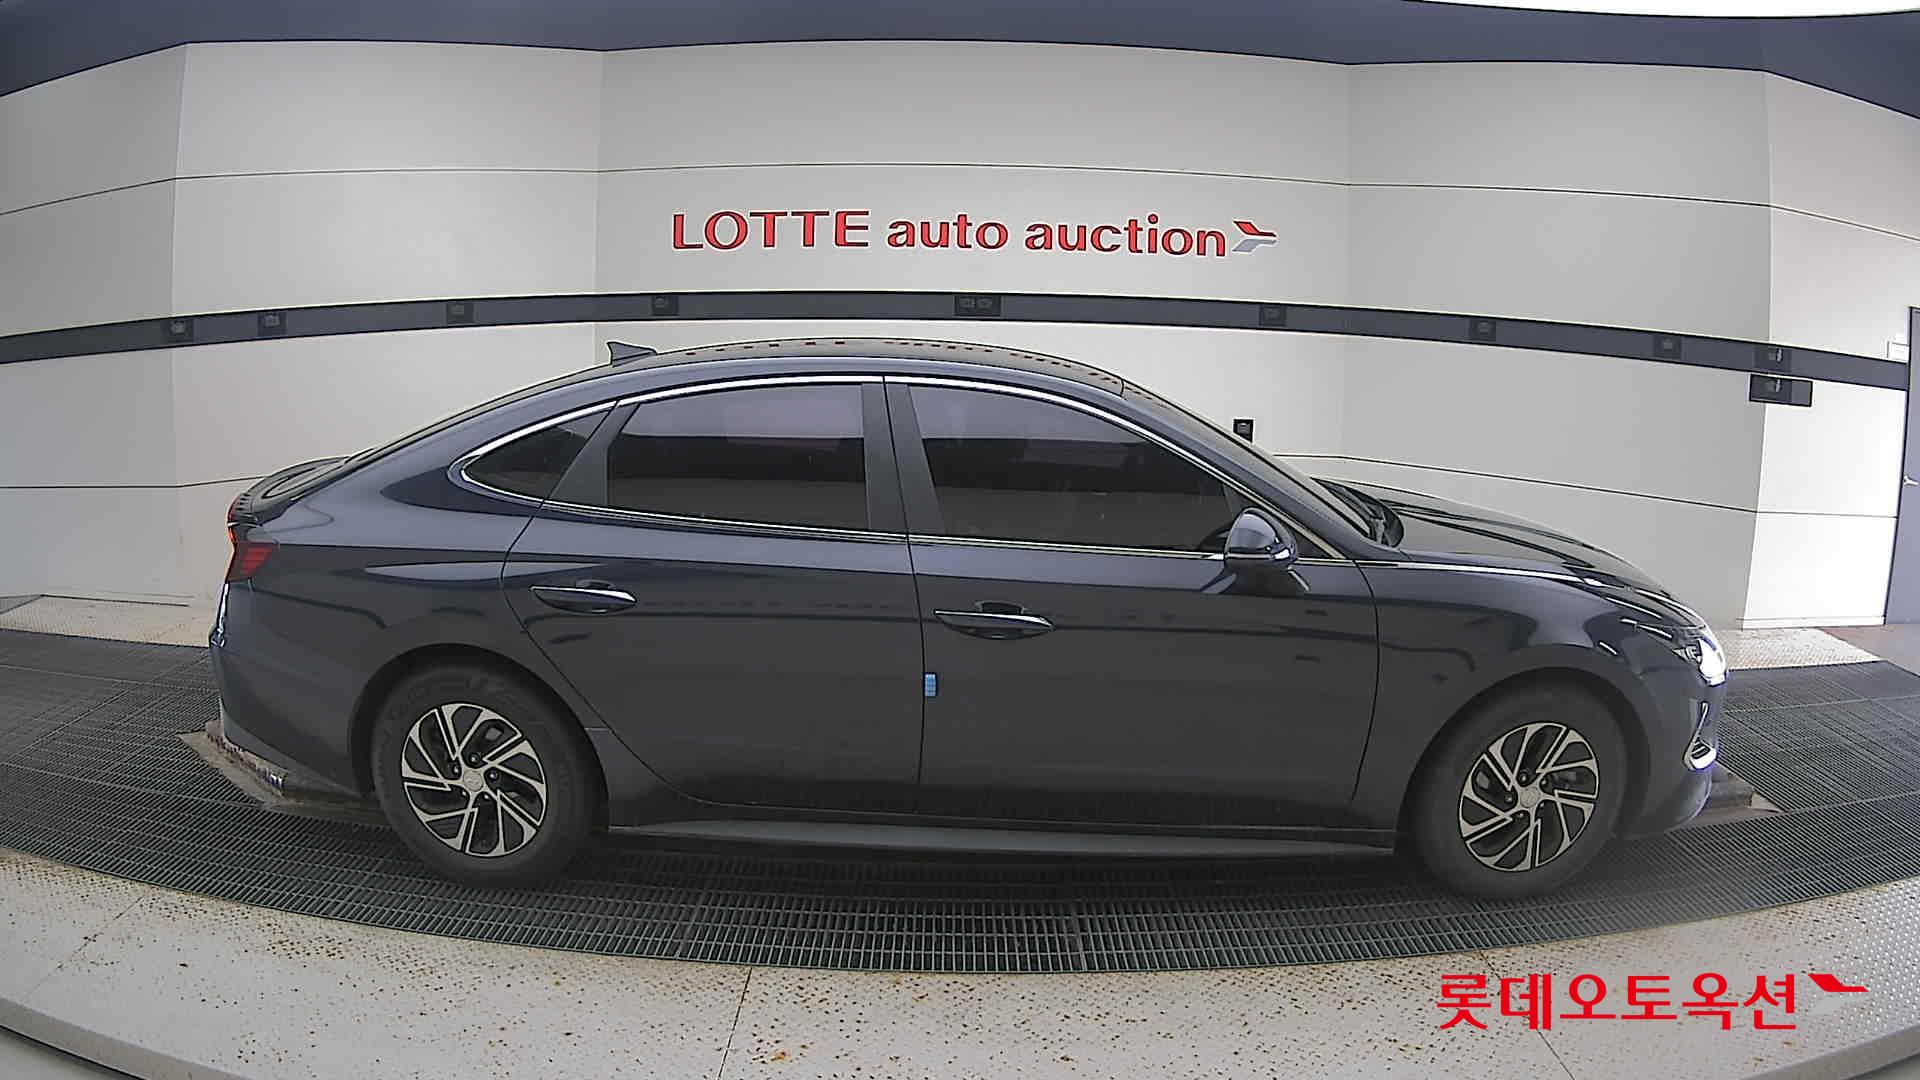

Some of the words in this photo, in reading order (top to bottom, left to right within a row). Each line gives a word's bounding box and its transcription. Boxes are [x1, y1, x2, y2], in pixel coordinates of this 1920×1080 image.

[673, 210, 870, 249] LOTTE
[887, 213, 1009, 249] auto
[1024, 214, 1227, 257] auction
